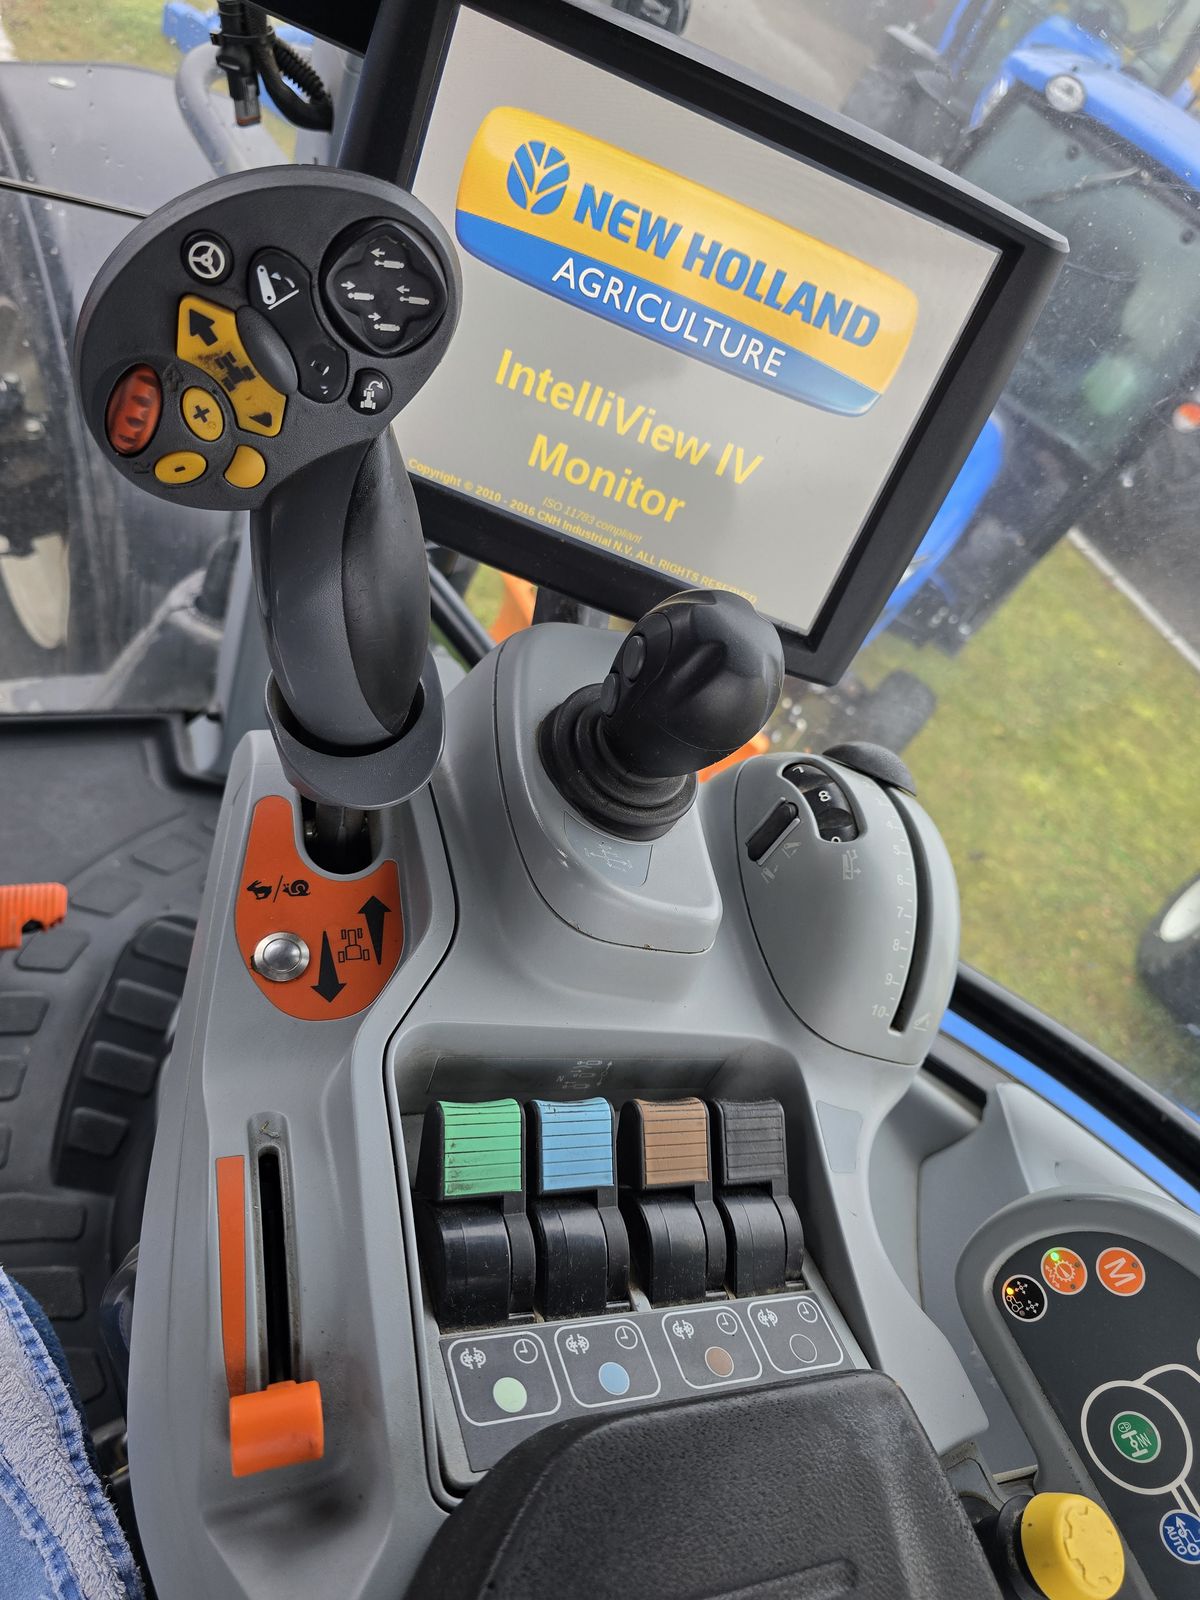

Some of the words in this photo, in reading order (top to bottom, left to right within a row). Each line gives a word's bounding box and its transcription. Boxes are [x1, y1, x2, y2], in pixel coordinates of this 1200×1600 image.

[573, 182, 683, 260] NEW
[682, 231, 880, 348] HOLLAND
[552, 257, 787, 378] AGRICULTURE
[495, 348, 711, 467] IntelliView
[714, 441, 765, 486] IV
[527, 433, 686, 523] Monitor
[407, 457, 462, 489] Copyright
[475, 483, 502, 502] 2010
[509, 498, 536, 517] 2016
[536, 510, 562, 528] CNH
[562, 519, 612, 548] Industrial
[612, 542, 634, 558] N.V.
[635, 549, 657, 566] ALL
[658, 557, 701, 583] RIGHTS
[542, 496, 563, 513] ISO
[564, 503, 594, 525] 11783
[594, 519, 643, 545] compliant
[818, 790, 831, 802] 8
[896, 905, 904, 918] 7
[892, 938, 900, 951] 8
[871, 1003, 886, 1018] 10
[1103, 1256, 1137, 1287] M
[1164, 1525, 1188, 1556] AUTO
